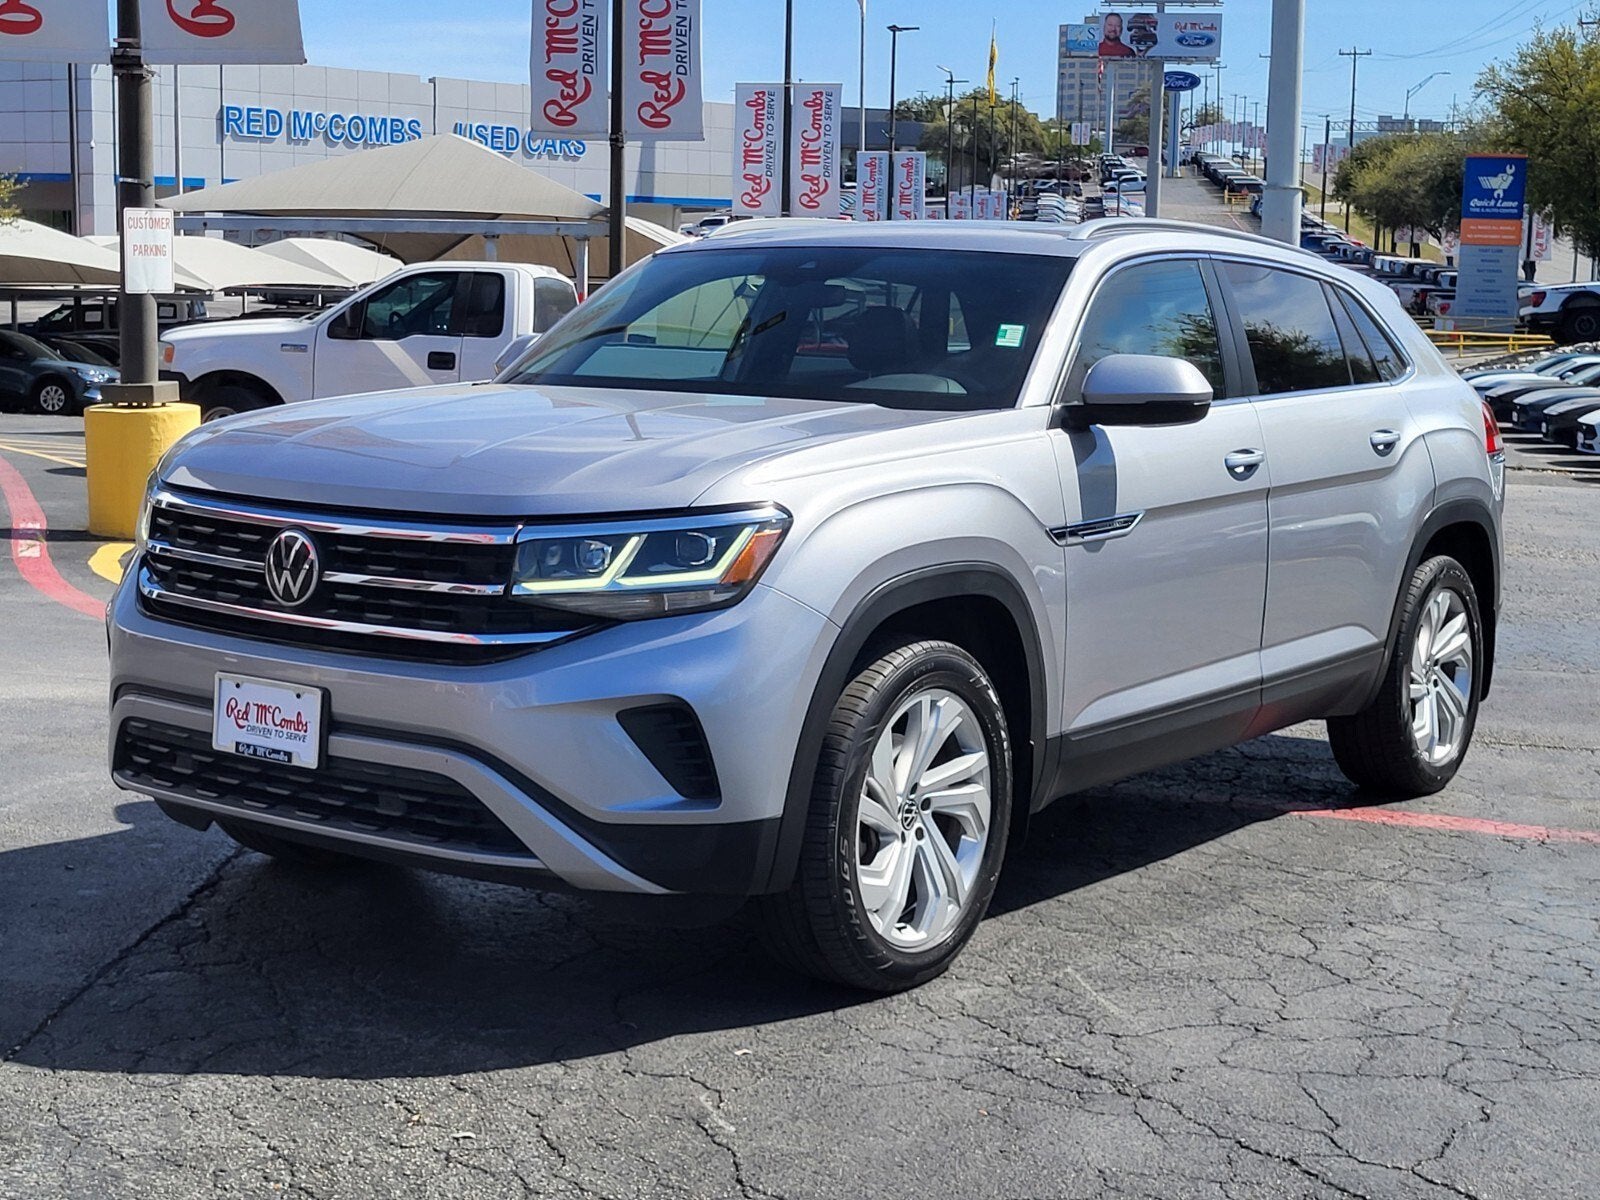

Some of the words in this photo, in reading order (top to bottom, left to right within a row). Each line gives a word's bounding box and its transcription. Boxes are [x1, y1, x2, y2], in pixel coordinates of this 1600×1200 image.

[582, 15, 595, 75] DRIVEN
[675, 16, 688, 76] DRIVEN
[1183, 34, 1208, 46] Ford
[543, 68, 592, 127] Red
[1164, 75, 1192, 87] Ford
[637, 70, 686, 129] Red
[767, 91, 775, 121] SERVE
[824, 91, 833, 122] SERVE
[225, 106, 283, 137] RED
[292, 110, 422, 145] McCOMBS
[743, 90, 767, 170] McCombs
[766, 124, 775, 138] TO
[801, 91, 824, 171] McCombs
[824, 124, 832, 138] TO
[765, 141, 774, 178] DRIVEN
[823, 141, 832, 178] DRIVEN
[741, 173, 772, 209] Red
[799, 174, 829, 209] Red
[863, 157, 877, 207] McCombs
[899, 157, 914, 207] McCombs
[1470, 198, 1495, 207] Quick
[1496, 199, 1518, 207] Lane
[128, 216, 171, 230] CUSTOMER
[132, 244, 167, 257] PARKING
[226, 697, 250, 730] Red
[253, 703, 308, 734] McCombs
[246, 724, 273, 737] DRIVEN
[274, 729, 285, 739] TO
[285, 731, 308, 743] SERVE
